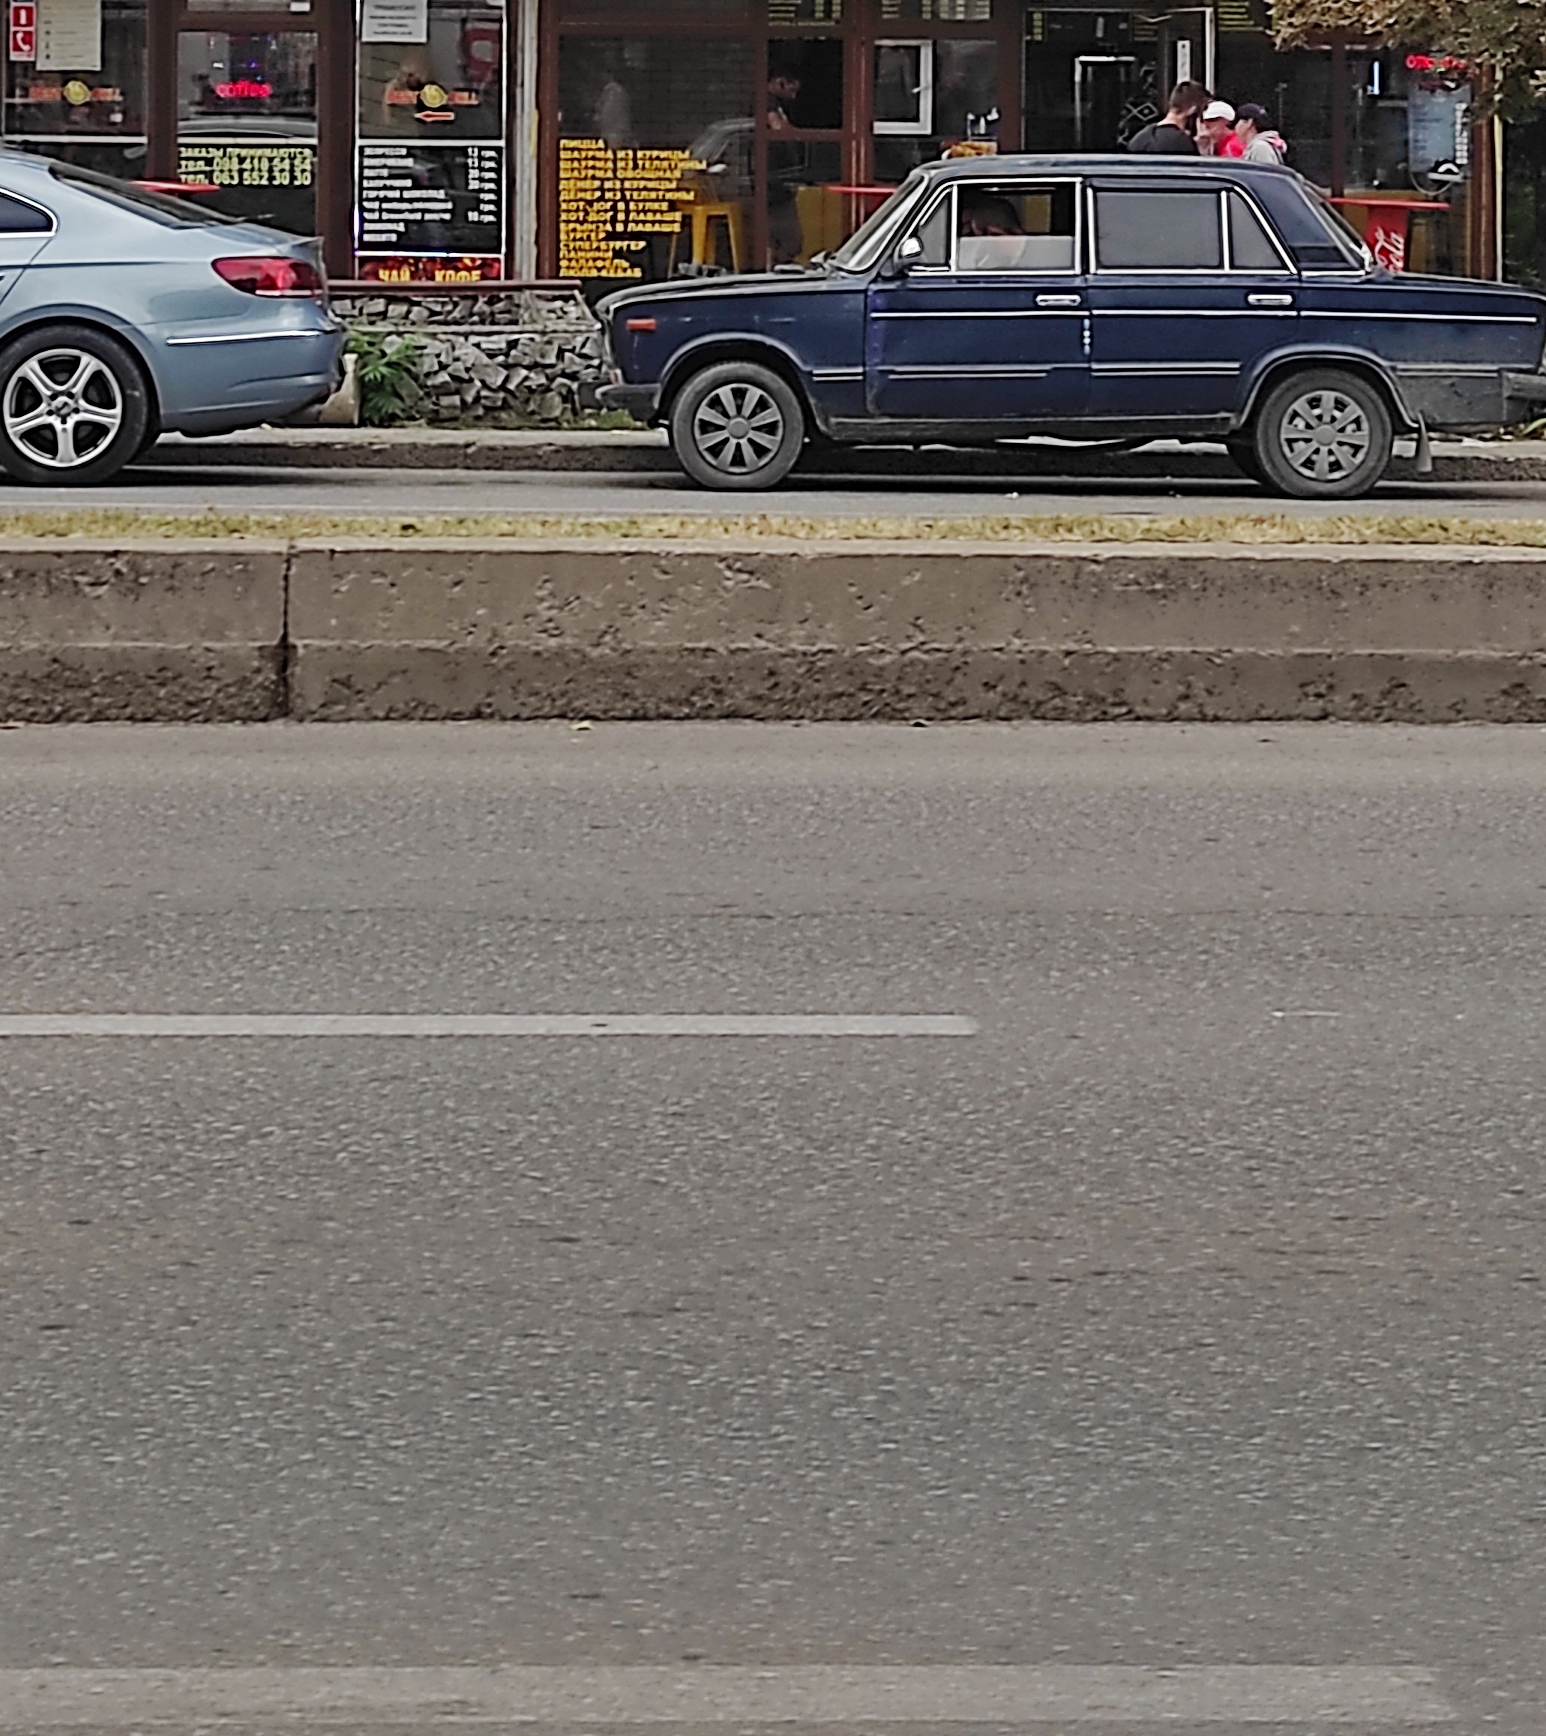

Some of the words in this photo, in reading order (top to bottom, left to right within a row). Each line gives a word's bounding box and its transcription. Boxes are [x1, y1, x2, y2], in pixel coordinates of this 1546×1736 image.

[242, 171, 270, 185] 552
[272, 171, 290, 185] 30
[293, 171, 312, 185] 30
[378, 265, 411, 282] ЧАЙ
[434, 269, 482, 282] КОФЕ
